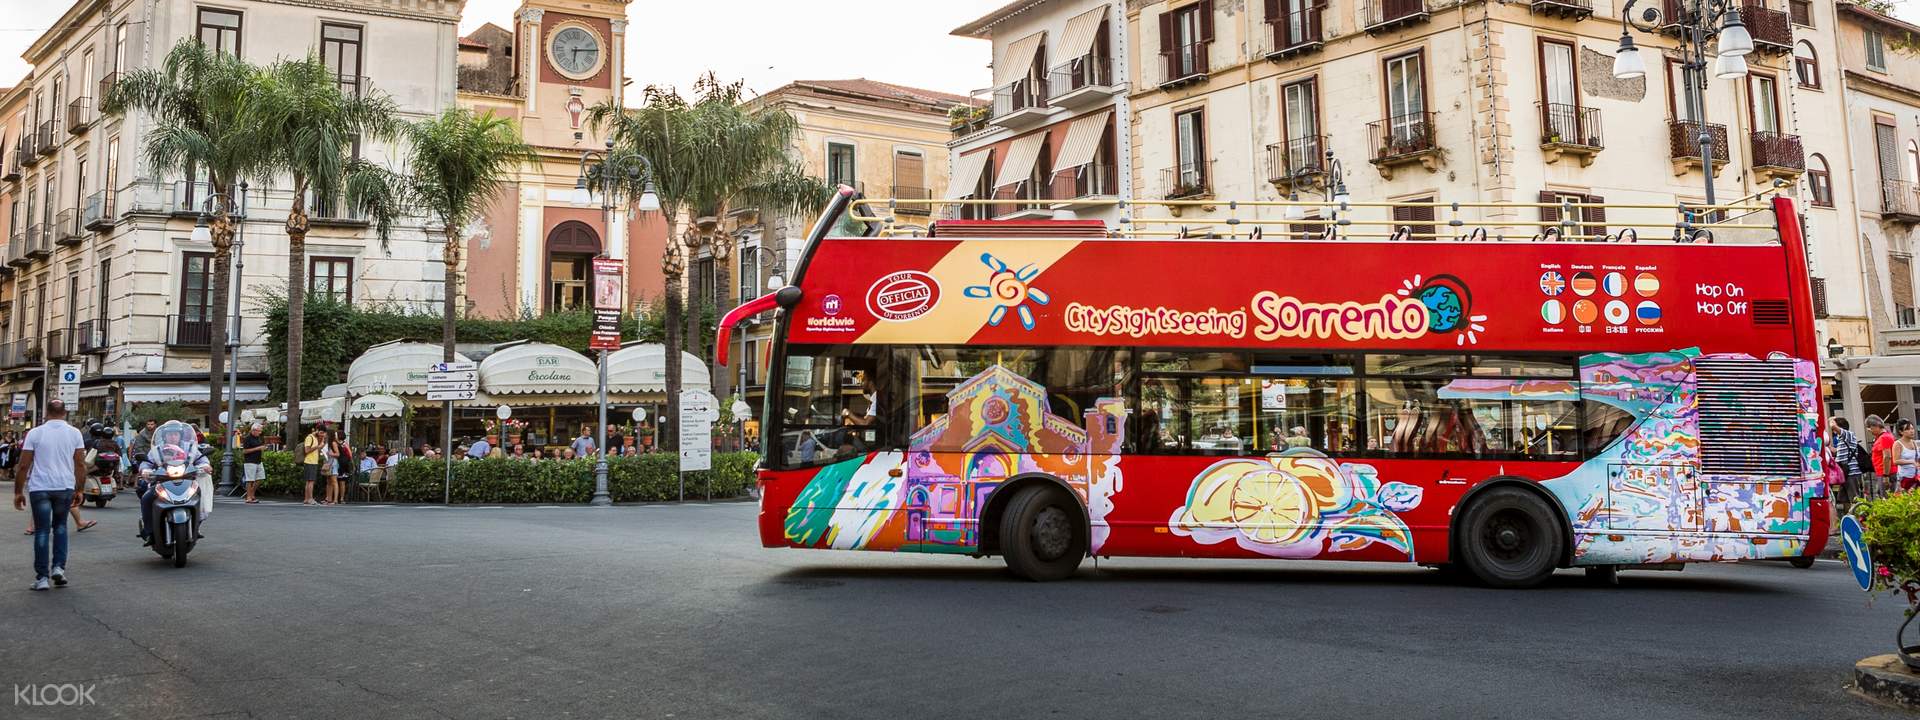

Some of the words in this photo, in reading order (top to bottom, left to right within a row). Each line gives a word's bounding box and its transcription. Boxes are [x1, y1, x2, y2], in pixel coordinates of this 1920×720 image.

[888, 273, 912, 283] TOUR
[880, 287, 929, 305] OFFICIAL
[1696, 283, 1722, 298] Hop
[1726, 283, 1744, 297] On
[883, 311, 893, 319] OF
[894, 304, 929, 320] SORRENTO
[1252, 291, 1430, 341] Sorrento
[1697, 301, 1723, 316] Hop
[1727, 301, 1748, 315] Off
[528, 370, 571, 380] Ercolano
[360, 402, 376, 410] BAR
